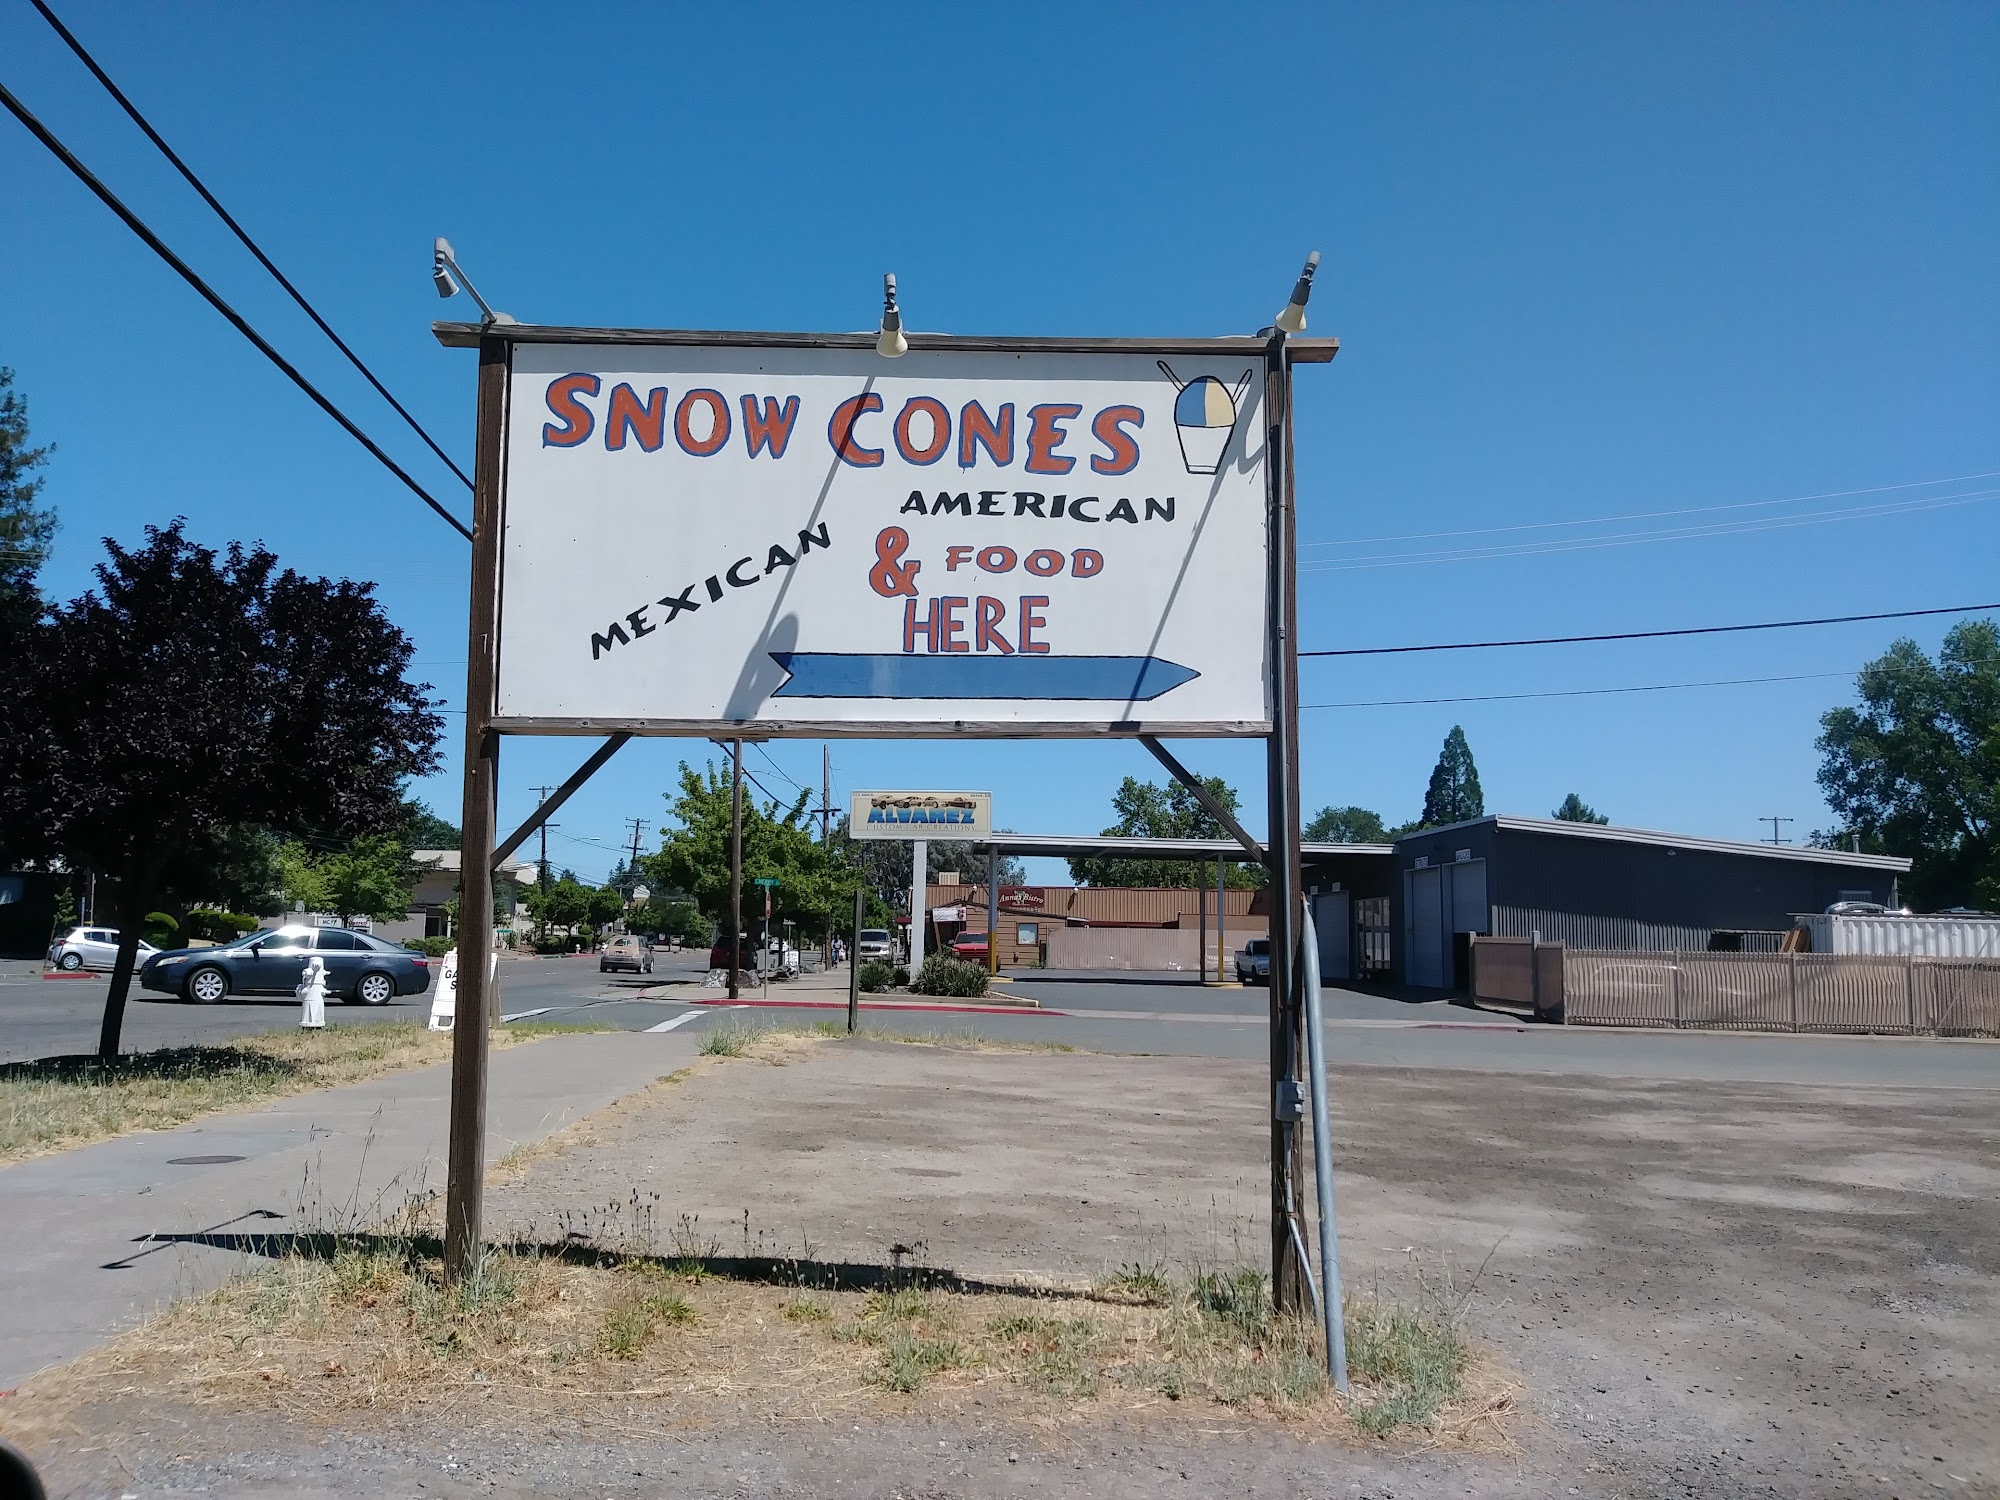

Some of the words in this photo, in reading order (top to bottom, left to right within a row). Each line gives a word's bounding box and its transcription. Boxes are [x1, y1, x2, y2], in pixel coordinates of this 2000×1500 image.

[542, 372, 801, 460] SNOW
[828, 392, 1145, 476] CONES
[899, 489, 1176, 524] AMERICAN
[868, 526, 921, 598] &
[945, 545, 1104, 579] FOOD
[590, 522, 831, 660] MEXICAN
[902, 595, 1051, 655] HERE
[866, 808, 976, 824] ALVAREZ
[866, 823, 903, 831] CUSTOM
[927, 823, 976, 831] CREATIONS
[1023, 893, 1044, 904] Bistro
